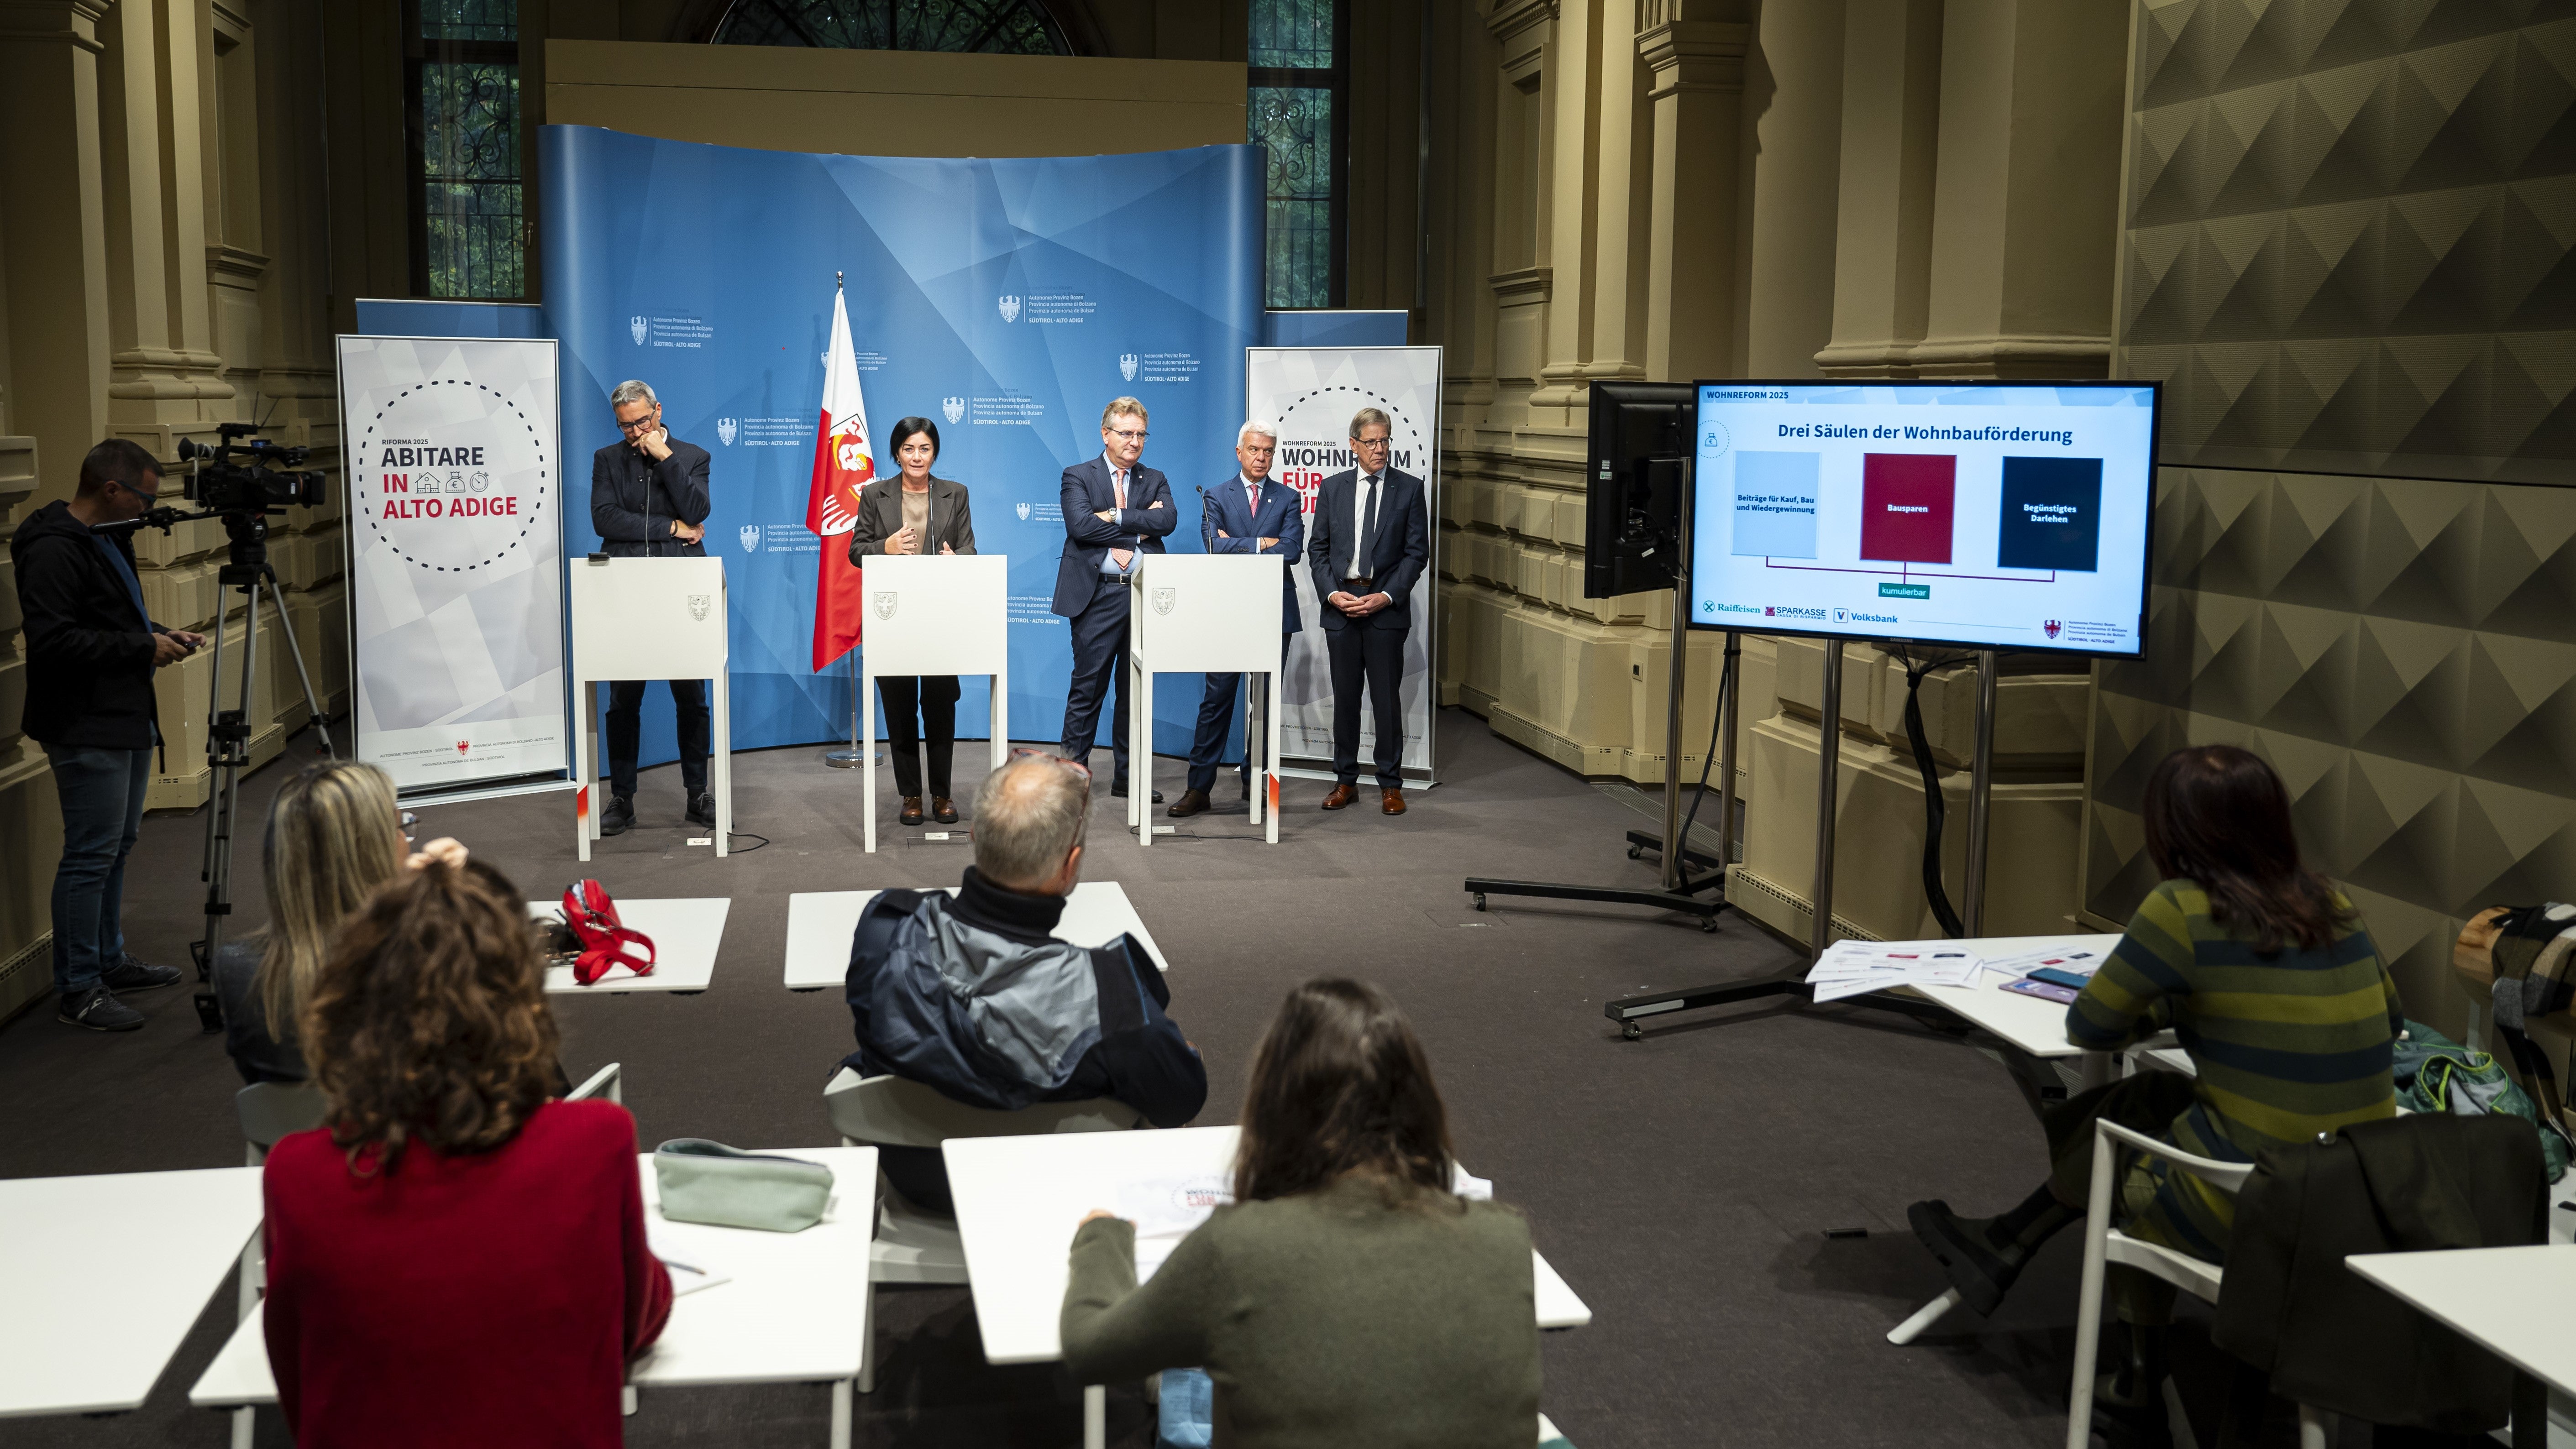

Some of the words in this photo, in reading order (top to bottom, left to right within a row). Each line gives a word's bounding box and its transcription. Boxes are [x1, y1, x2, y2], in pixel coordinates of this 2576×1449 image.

[1779, 424, 1810, 438] Drei
[1814, 424, 1868, 439] Säulen
[1873, 425, 1900, 439] der
[1904, 425, 2073, 446] Wohnbauförderung
[381, 447, 484, 467] ABITARE
[383, 474, 408, 493] IN
[1283, 467, 1323, 490] FÜR
[383, 499, 443, 519] ALTO
[449, 497, 517, 517] ADIGE
[1752, 505, 1815, 514] Wiedergewinnung
[1888, 504, 1928, 513] Bausparen
[2024, 504, 2077, 514] Begünstigtes
[2031, 515, 2068, 523] Darlehen
[1882, 587, 1926, 596] kumulierbar
[1717, 603, 1760, 613] Raiffeisen
[1777, 607, 1826, 616] SPARKASSE
[1852, 613, 1898, 623] Volksbank
